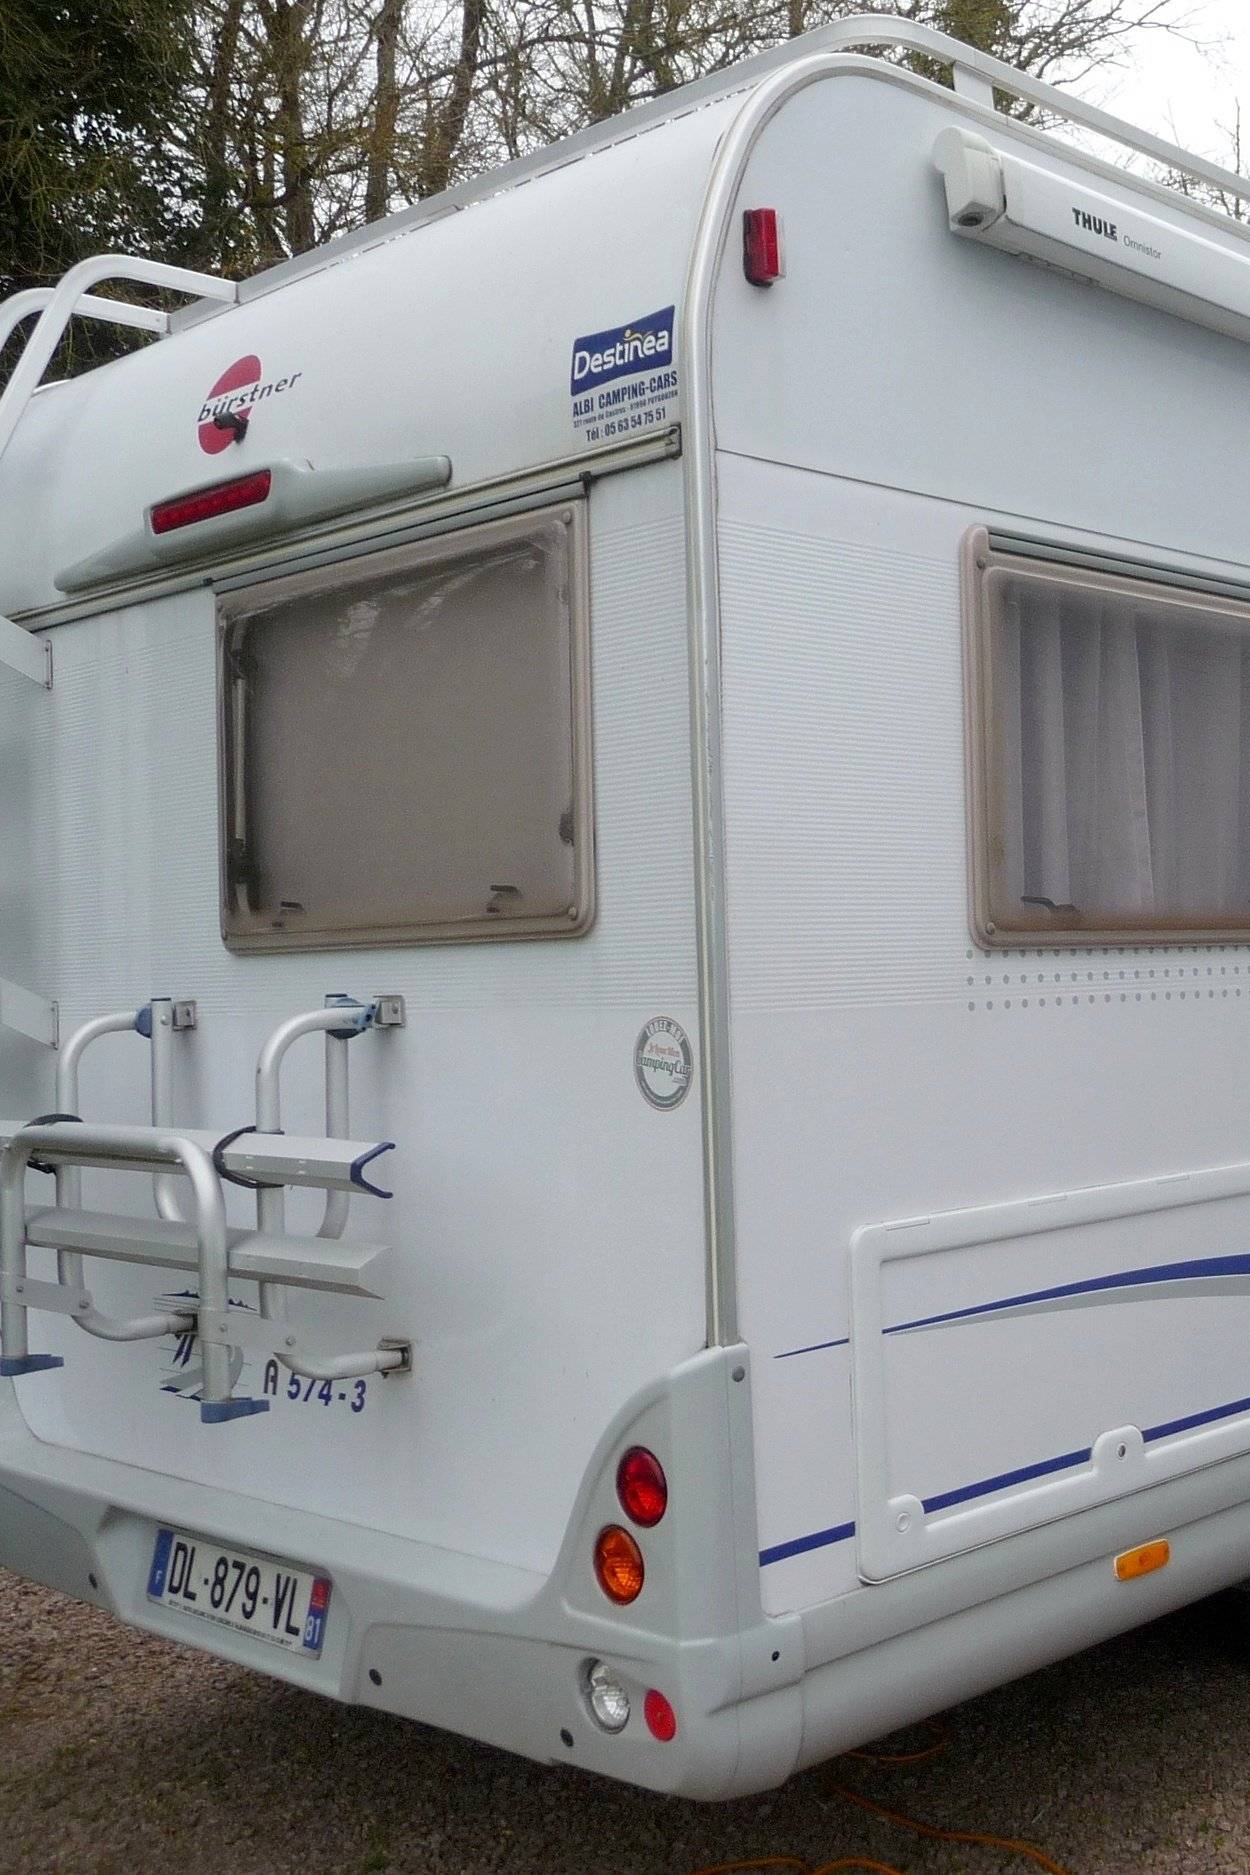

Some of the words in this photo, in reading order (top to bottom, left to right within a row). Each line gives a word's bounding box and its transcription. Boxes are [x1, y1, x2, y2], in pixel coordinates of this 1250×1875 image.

[1072, 207, 1118, 242] THULE
[1123, 235, 1162, 259] Omnistor
[573, 397, 594, 417] ALBI
[598, 371, 678, 409] CAMPING-CARS
[604, 422, 617, 437] 05
[617, 418, 630, 433] 63
[631, 413, 643, 429] 54
[643, 410, 654, 425] 75
[655, 407, 666, 420] 51
[263, 1358, 279, 1396] A
[168, 1541, 300, 1636] DL-879-VL
[305, 1615, 322, 1644] 81
